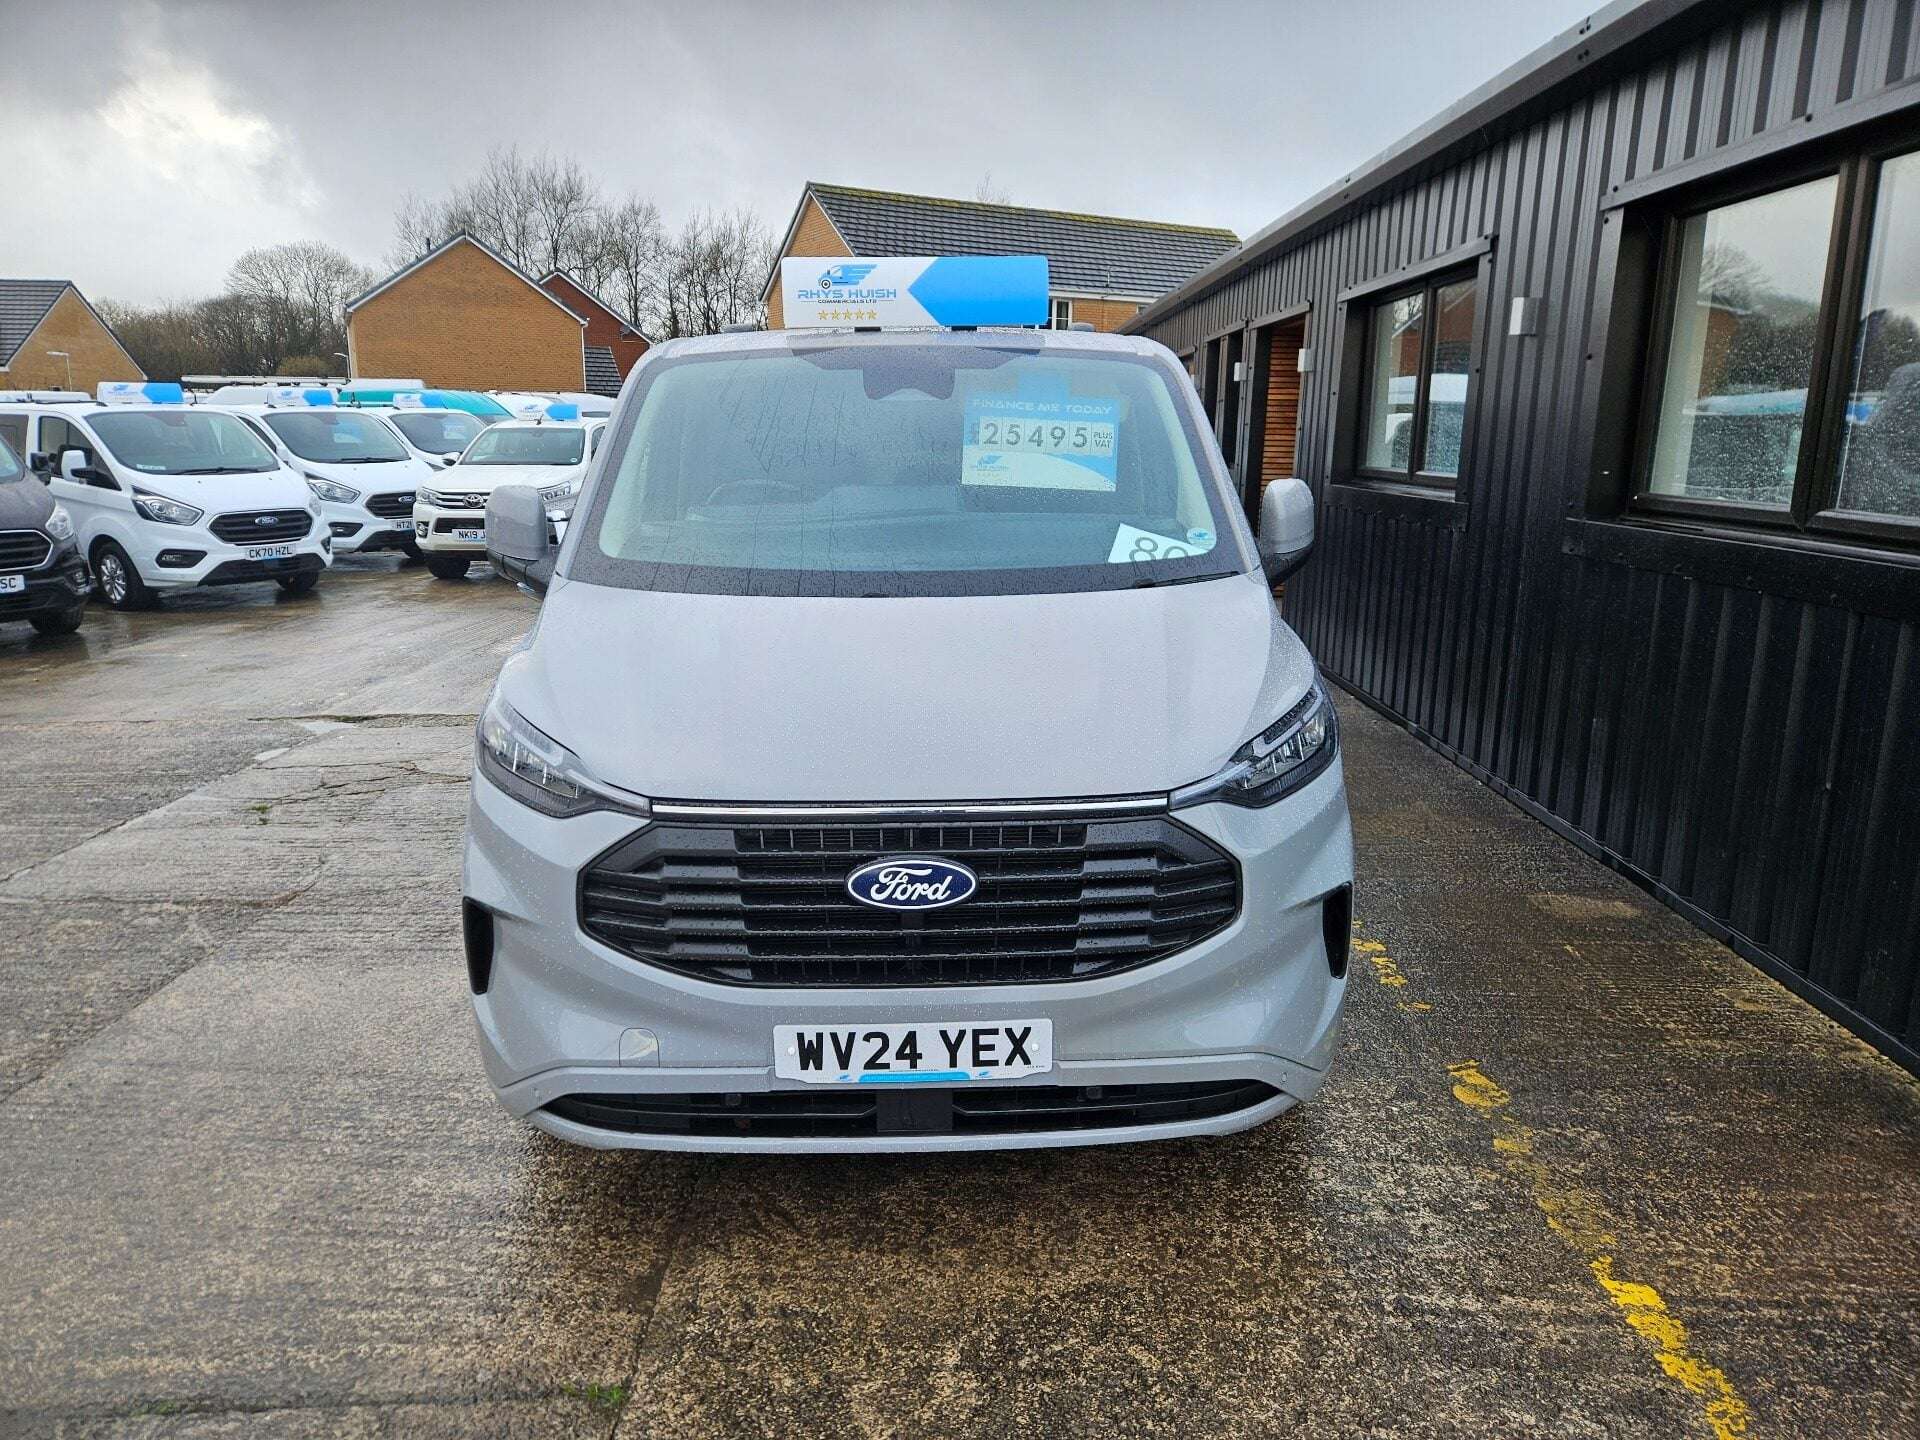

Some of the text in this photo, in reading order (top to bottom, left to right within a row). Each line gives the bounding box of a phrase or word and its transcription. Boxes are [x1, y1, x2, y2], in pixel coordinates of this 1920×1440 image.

[798, 288, 897, 299] RHYS HUISH
[973, 400, 1113, 415] FINANCE ME TODAY
[1093, 431, 1113, 440] PLUS
[1094, 439, 1112, 448] VAT
[458, 530, 478, 539] NK19
[248, 546, 293, 559] CK70 HZL
[870, 866, 953, 902] Ford
[796, 1026, 1033, 1071] WV24 YEX
